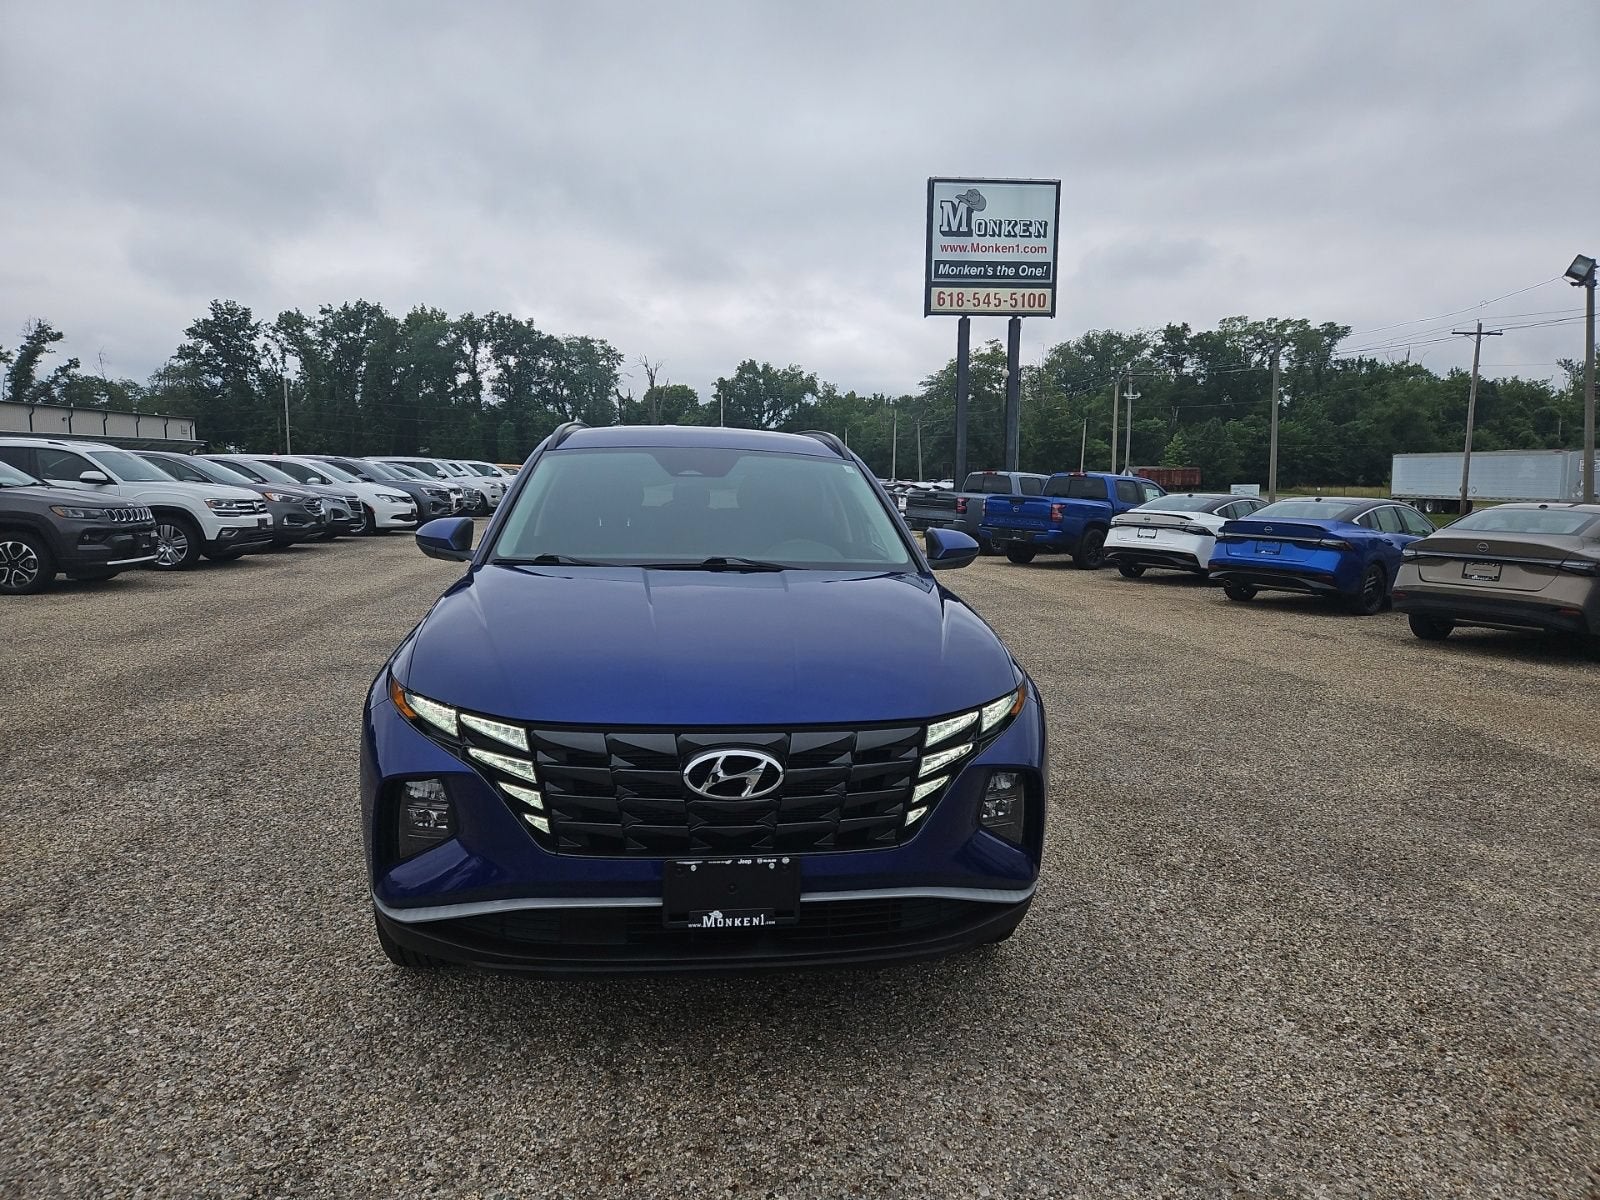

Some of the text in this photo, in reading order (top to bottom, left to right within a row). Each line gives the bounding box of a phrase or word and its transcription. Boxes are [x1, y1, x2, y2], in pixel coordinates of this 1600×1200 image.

[940, 200, 1048, 238] MONKEN
[940, 243, 1047, 254] www.Monken1.com
[938, 264, 1047, 276] Monken's the One!
[937, 291, 1047, 308] 618-545-5100
